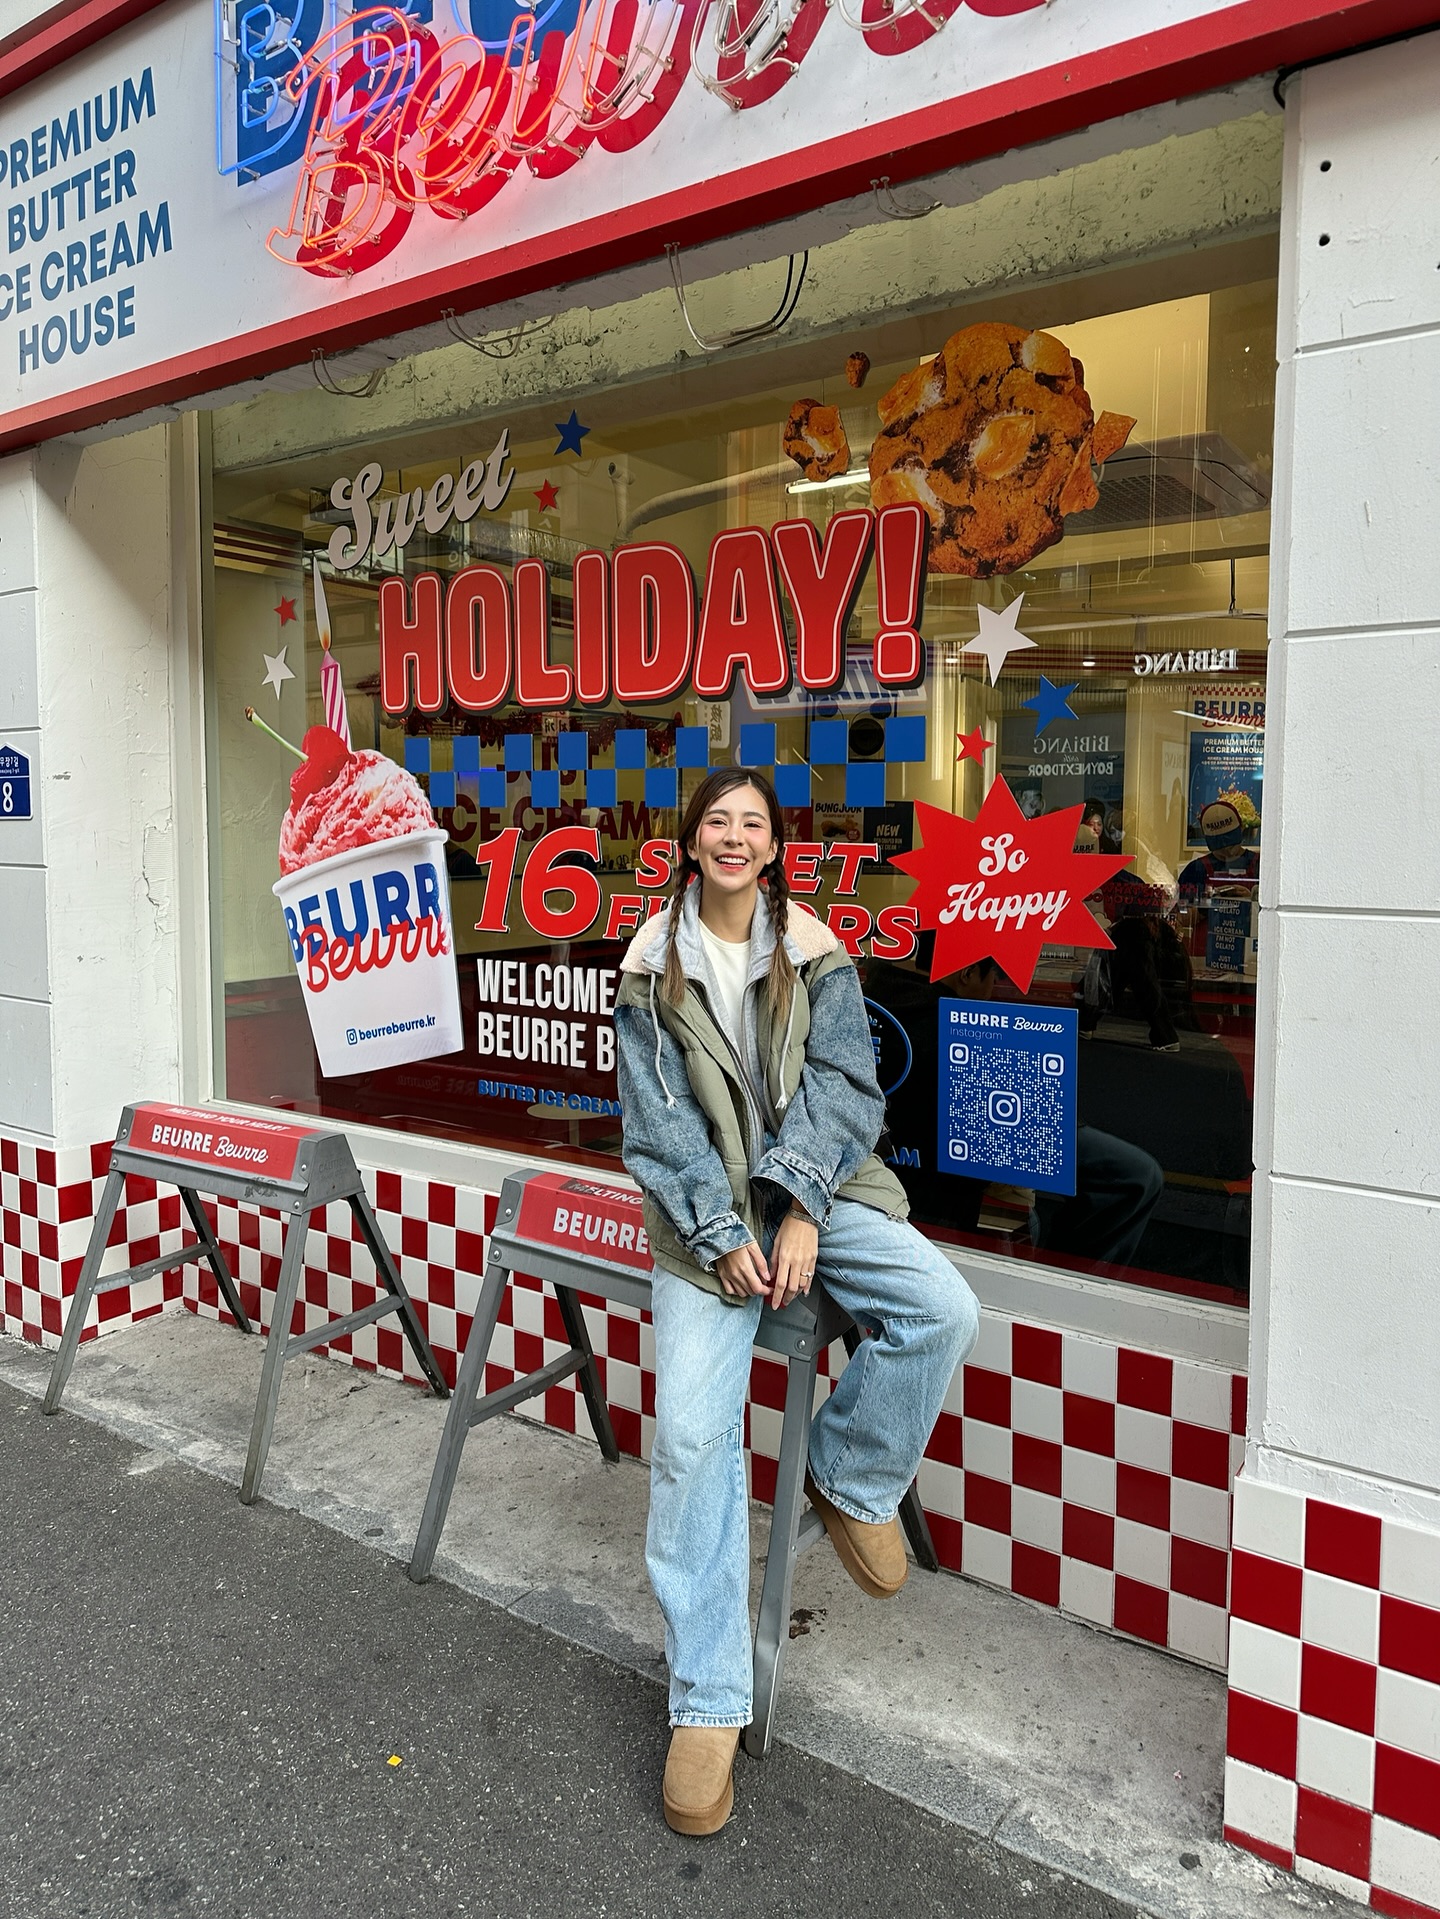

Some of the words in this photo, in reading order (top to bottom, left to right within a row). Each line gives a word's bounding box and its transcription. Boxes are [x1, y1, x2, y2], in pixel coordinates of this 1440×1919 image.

[8, 149, 138, 254] BUTTER
[0, 263, 32, 322] CE
[39, 201, 173, 302] CREAM
[19, 285, 136, 375] HOUSE
[328, 427, 515, 570] Sweet
[379, 501, 929, 714] HOLIDAY!
[1195, 701, 1265, 719] BEURR
[1216, 746, 1242, 754] CREAM
[1243, 746, 1264, 754] HOUS
[2, 781, 14, 813] 8
[784, 822, 800, 836] EW
[876, 824, 901, 837] NEW
[1073, 843, 1095, 851] URRE
[979, 832, 1029, 877] So
[474, 825, 602, 939] 16
[635, 838, 879, 896] SET
[284, 862, 440, 963] BEURR
[938, 880, 1071, 932] Happy
[1215, 942, 1235, 951] GELATO
[476, 957, 617, 1017] WELCOME
[359, 1014, 436, 1041] beurrebeurre.kr
[949, 1026, 1003, 1040] Instagram
[950, 1010, 1009, 1028] BEURRE
[477, 1010, 587, 1070] BEURRE
[478, 1079, 536, 1103] BUTTER
[538, 1089, 565, 1108] ICE
[151, 1123, 213, 1154] BEURRE
[553, 1207, 650, 1255] BEURRE
